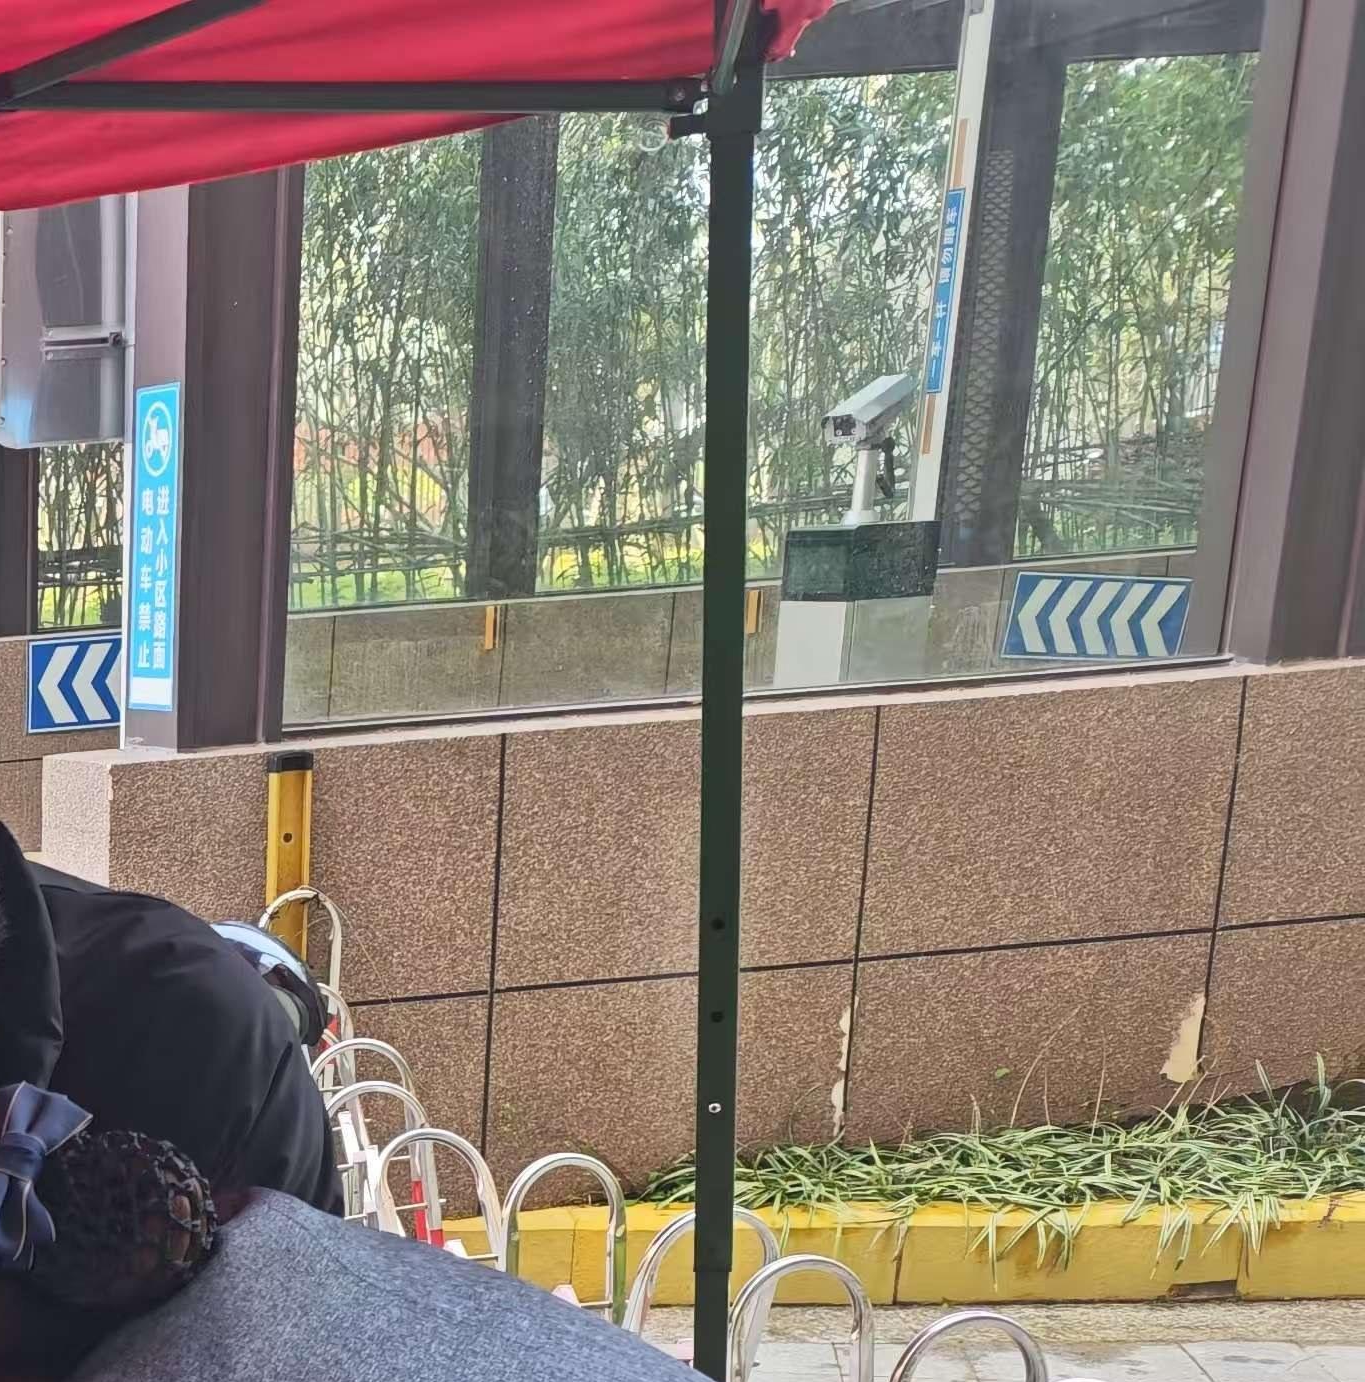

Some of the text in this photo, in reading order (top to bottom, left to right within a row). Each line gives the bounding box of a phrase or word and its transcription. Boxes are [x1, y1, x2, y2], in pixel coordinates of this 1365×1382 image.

[137, 487, 154, 668] 电动车禁止
[153, 485, 169, 669] 进入小区路面
